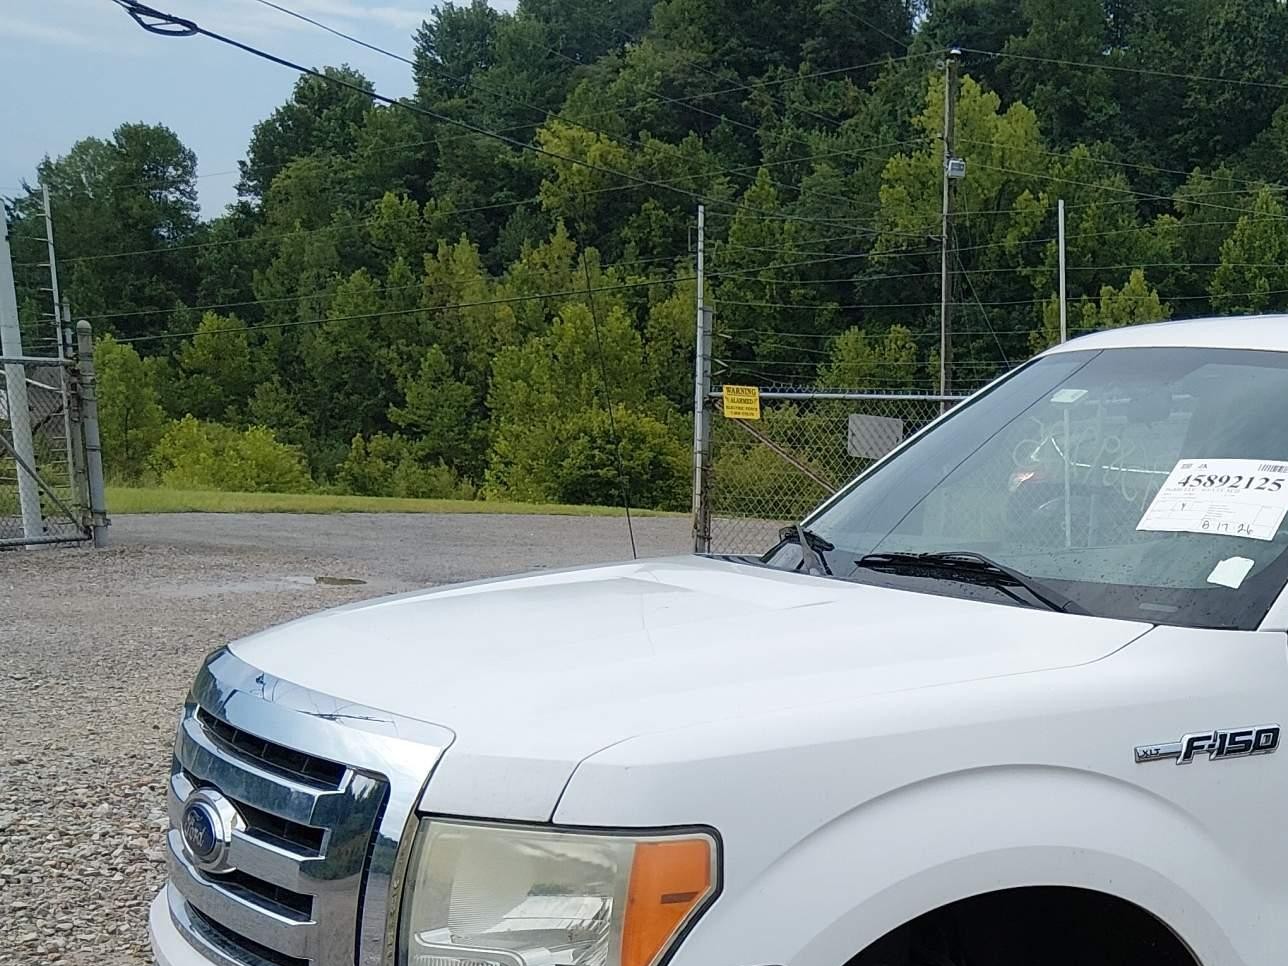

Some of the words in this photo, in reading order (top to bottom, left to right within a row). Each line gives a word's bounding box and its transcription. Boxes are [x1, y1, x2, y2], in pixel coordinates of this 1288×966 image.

[725, 386, 757, 396] WARNING
[1177, 473, 1286, 492] 45892125
[1177, 723, 1281, 765] F-150
[183, 808, 208, 849] Ford
